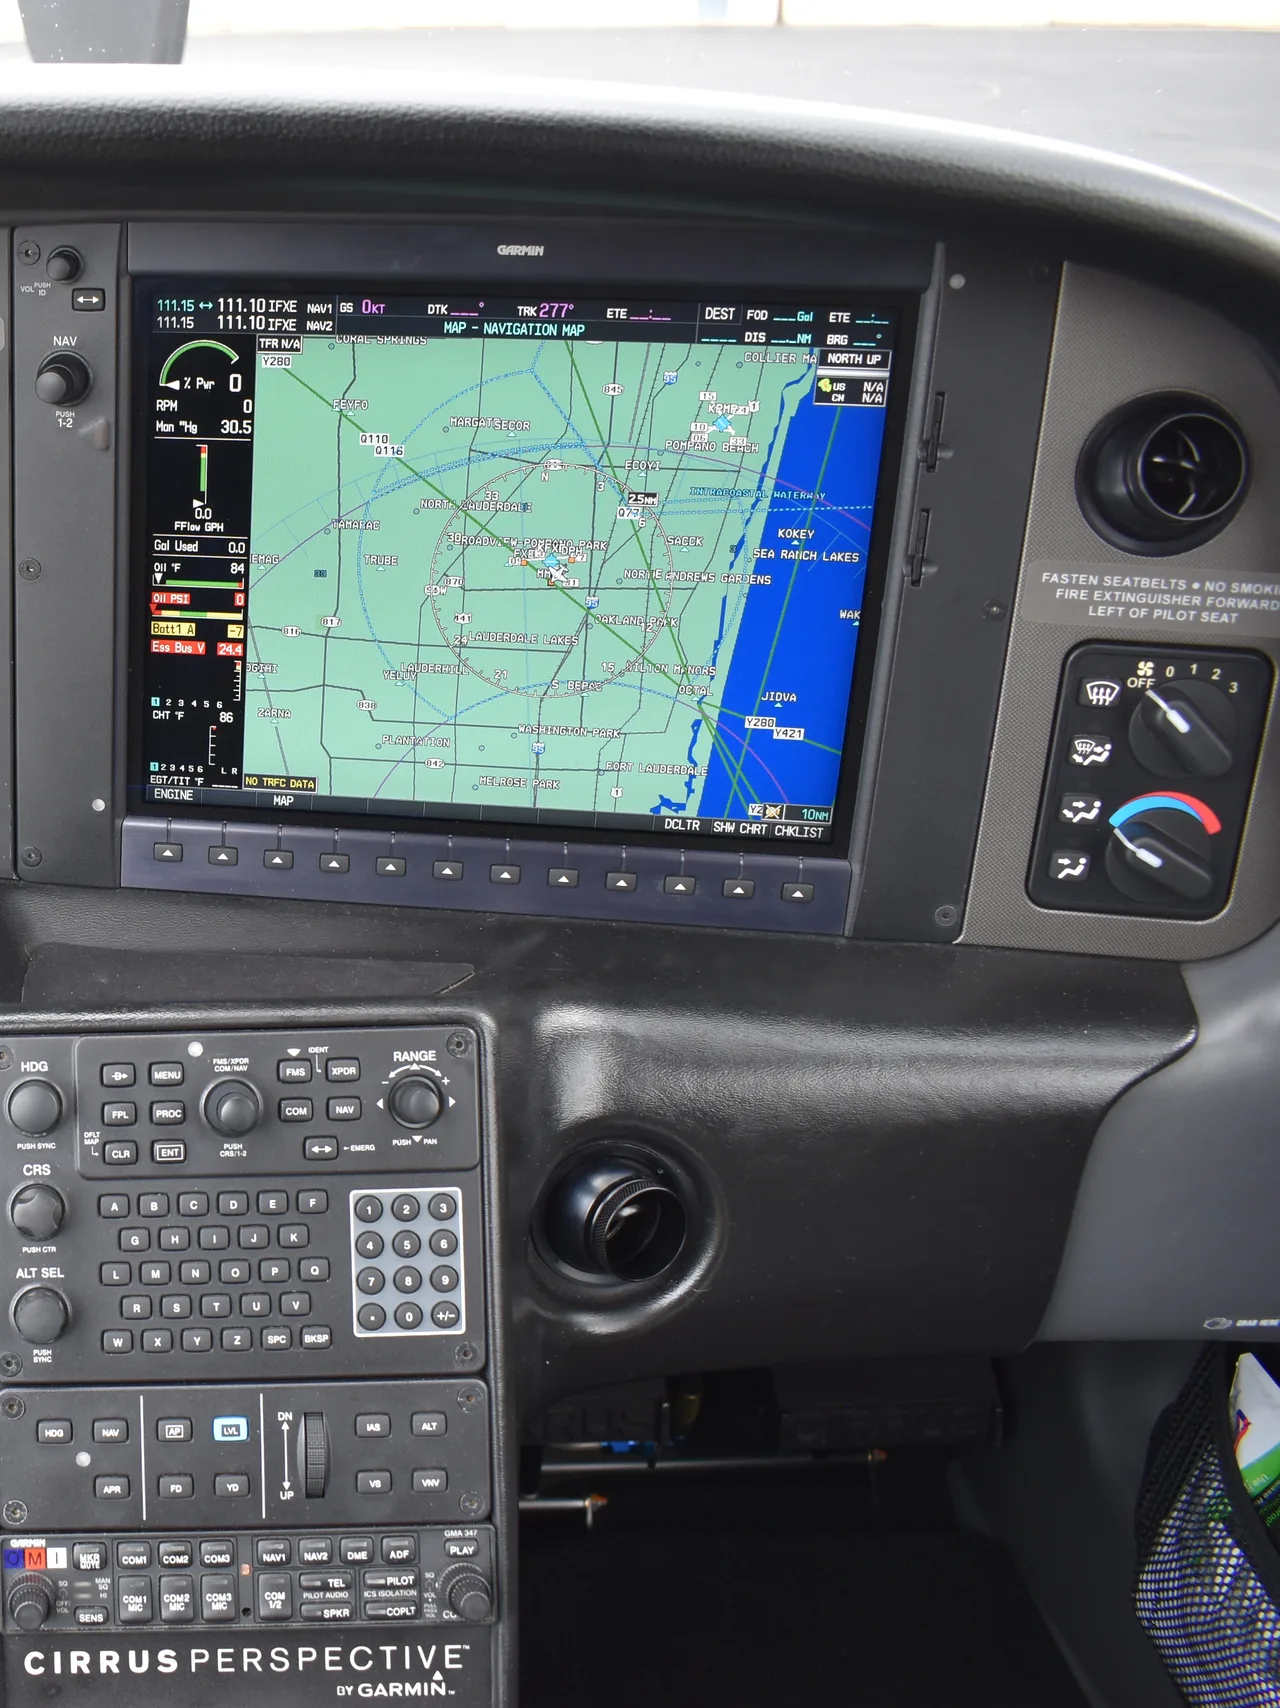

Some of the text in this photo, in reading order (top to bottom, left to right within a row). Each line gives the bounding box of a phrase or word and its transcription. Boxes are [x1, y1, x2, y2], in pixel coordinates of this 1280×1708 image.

[497, 245, 544, 256] GARMIN
[157, 298, 332, 314] 111.15 111.10 IFXE NAV1
[427, 304, 448, 314] DTK
[518, 306, 537, 316] TRK
[705, 308, 735, 320] DEST
[747, 310, 768, 320] FOD
[829, 312, 850, 323] ETE
[156, 315, 333, 331] 111.15 111.10 IFXE NAV2
[444, 322, 585, 336] MAP NAVIGATION MAP
[53, 336, 78, 346] NAV
[827, 334, 848, 345] BRG
[827, 353, 882, 365] NORTH UP
[156, 400, 178, 412] RPM
[778, 528, 814, 539] KOKEY
[154, 540, 245, 553] Gal Used 0.0
[364, 555, 398, 565] TRUBE
[753, 549, 859, 562] SEA RANCH LAKES
[1042, 572, 1187, 590] FASTEN SEATBELTS
[1056, 588, 1201, 606] FIRE EXTINGUISHER
[1089, 606, 1239, 623] LEFT OF PILOT SEAT
[1127, 678, 1155, 689] OFF
[762, 692, 797, 702] JIDVA
[258, 708, 291, 718] ZARNA
[382, 736, 450, 747] PLANTATION
[245, 777, 314, 789] NO TRFC DATA
[479, 777, 560, 790] MELROSE PARK
[154, 790, 193, 800] ENGINE
[665, 819, 700, 831] DCLTR
[714, 822, 767, 835] SHW CHRT
[775, 825, 824, 838] CHKLIST
[393, 1051, 436, 1062] RANGE
[21, 1061, 48, 1072] HDG
[332, 1067, 356, 1075] XPDR
[155, 1071, 181, 1079] MENU
[156, 1110, 182, 1118] PROC
[23, 1164, 51, 1175] CRS
[16, 1268, 64, 1278] ALT SEL
[268, 1335, 286, 1344] SPC
[305, 1335, 328, 1343] BKSP
[367, 1423, 380, 1431] IAS
[263, 1554, 285, 1562] NAV1
[323, 1609, 350, 1617] SPKR
[386, 1606, 416, 1616] COPLT
[79, 1614, 103, 1622] SENS
[24, 1649, 177, 1675] CIRRUS
[337, 1681, 446, 1697] BY GARMIN
